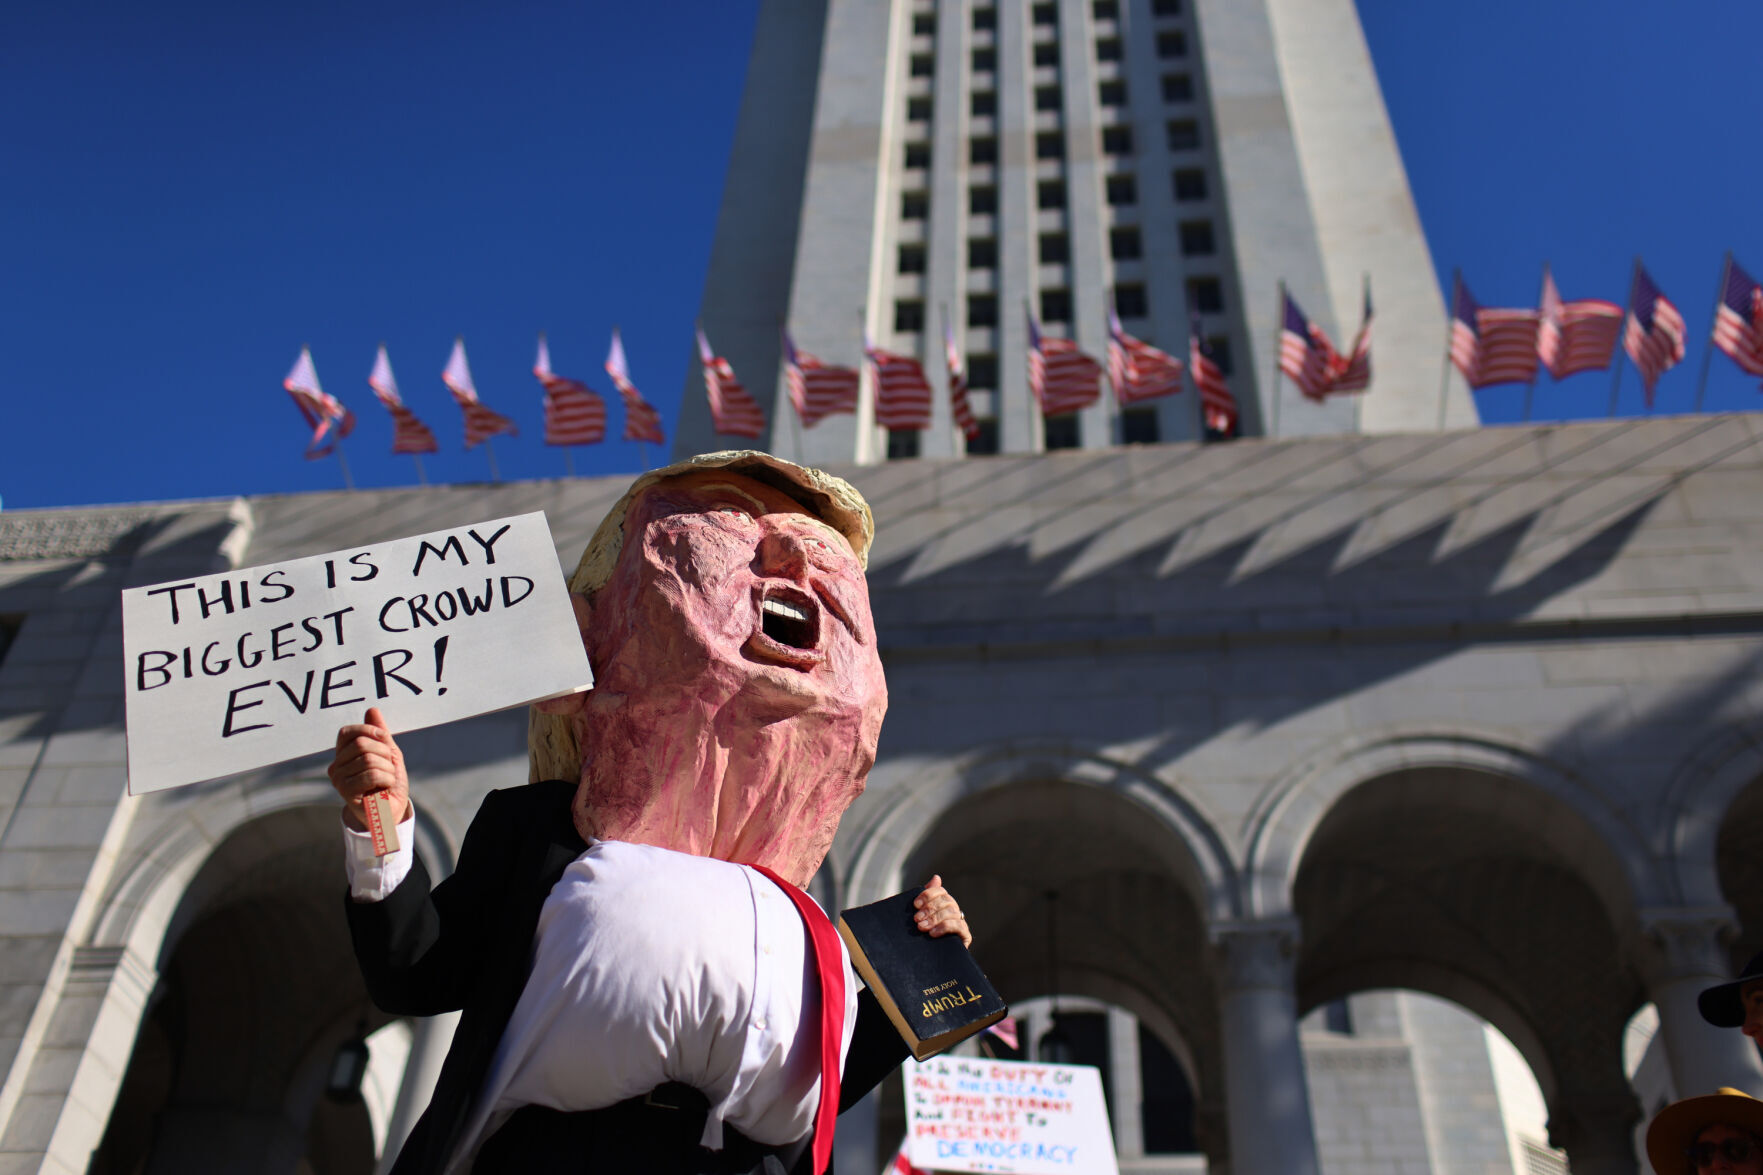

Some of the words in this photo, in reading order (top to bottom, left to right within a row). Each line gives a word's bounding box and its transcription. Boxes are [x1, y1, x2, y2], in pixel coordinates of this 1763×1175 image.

[147, 570, 295, 624] THIS
[325, 551, 379, 589] IS
[412, 524, 511, 577] MY
[137, 606, 354, 691] BIGGEST
[378, 575, 535, 633] CROWD
[221, 635, 450, 737] EVER!
[922, 985, 940, 996] BIBLE
[941, 978, 958, 991] HOLY
[922, 985, 982, 1018] TRUMP
[989, 1065, 1048, 1083] DUTY
[937, 1139, 1079, 1164] DEMOCRACY
